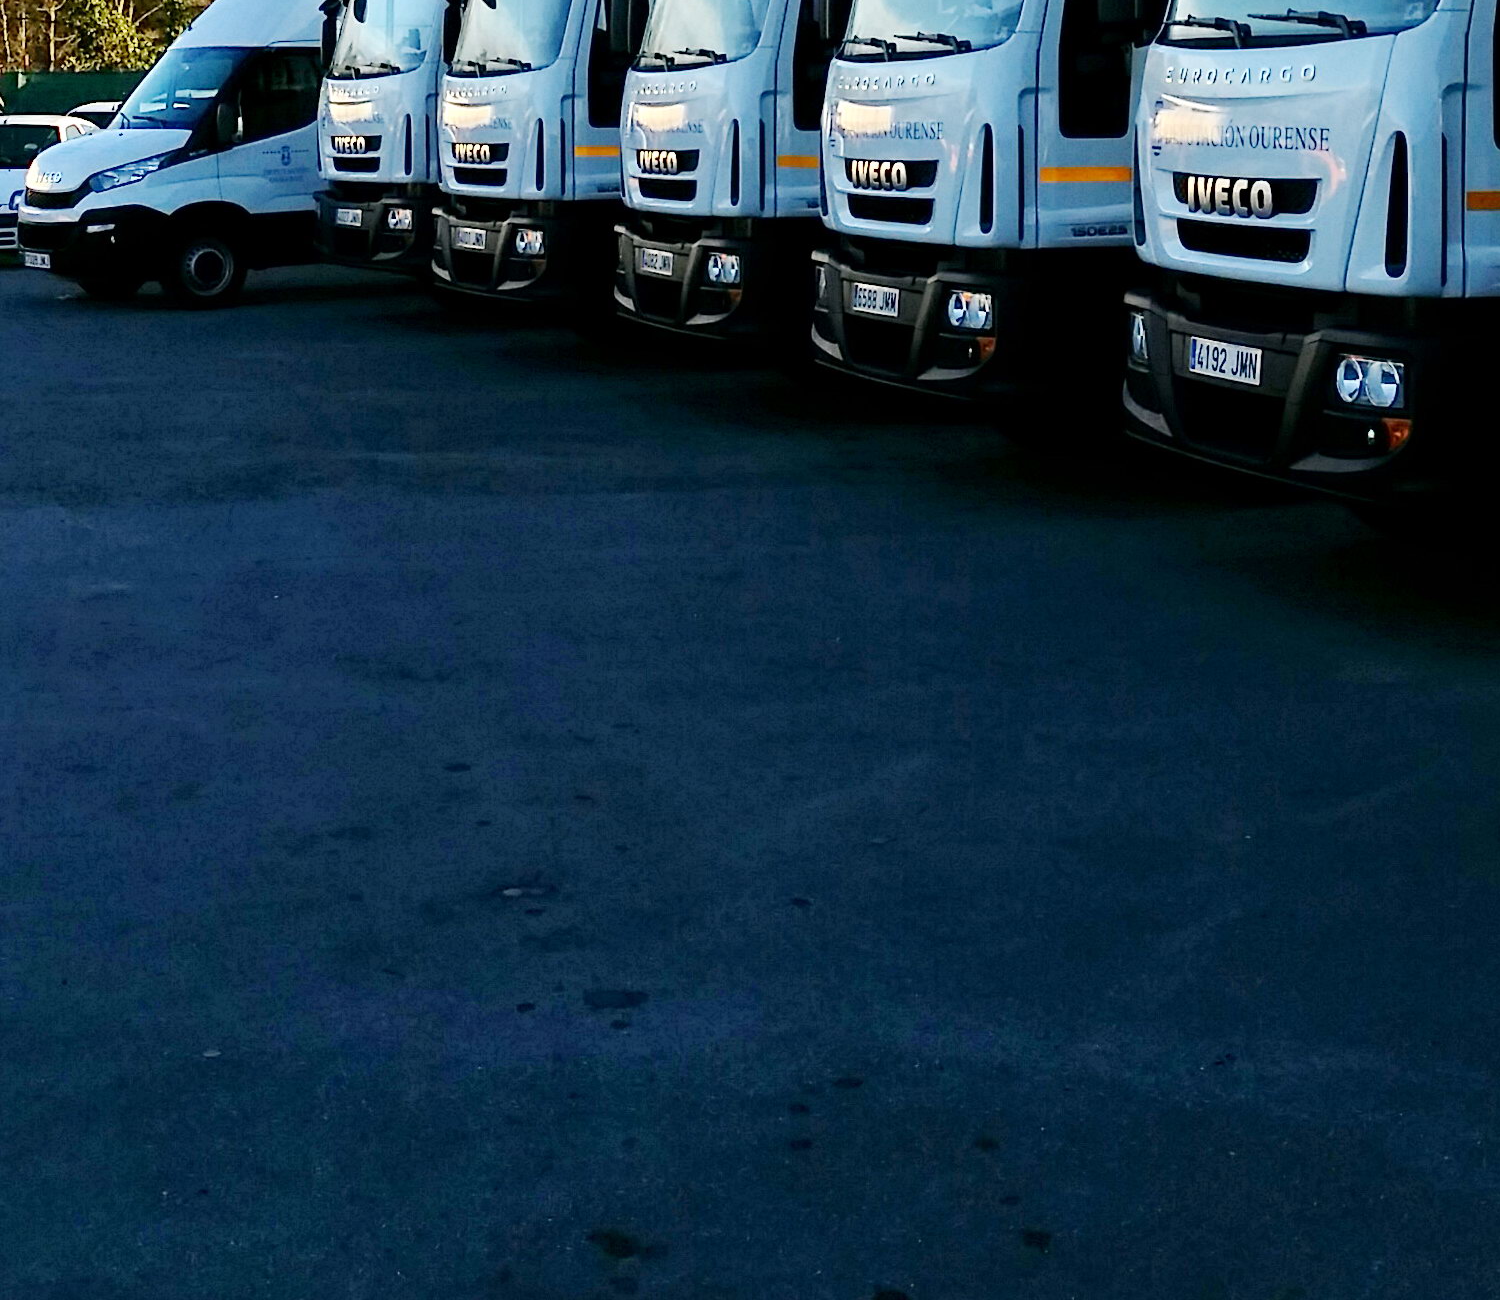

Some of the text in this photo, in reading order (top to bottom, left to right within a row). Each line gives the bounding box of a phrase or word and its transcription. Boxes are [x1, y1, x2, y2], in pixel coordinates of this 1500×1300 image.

[1164, 64, 1317, 85] EUROCARGO
[890, 121, 944, 140] OURENSE
[1164, 119, 1331, 152] TACIÓN OURENSE
[334, 136, 366, 154] IVECO
[455, 143, 490, 163] IVECO
[639, 150, 678, 175] IVECO
[851, 159, 908, 191] IVECO
[1186, 175, 1274, 219] IVECO
[1198, 343, 1258, 380] 4192 JMN
